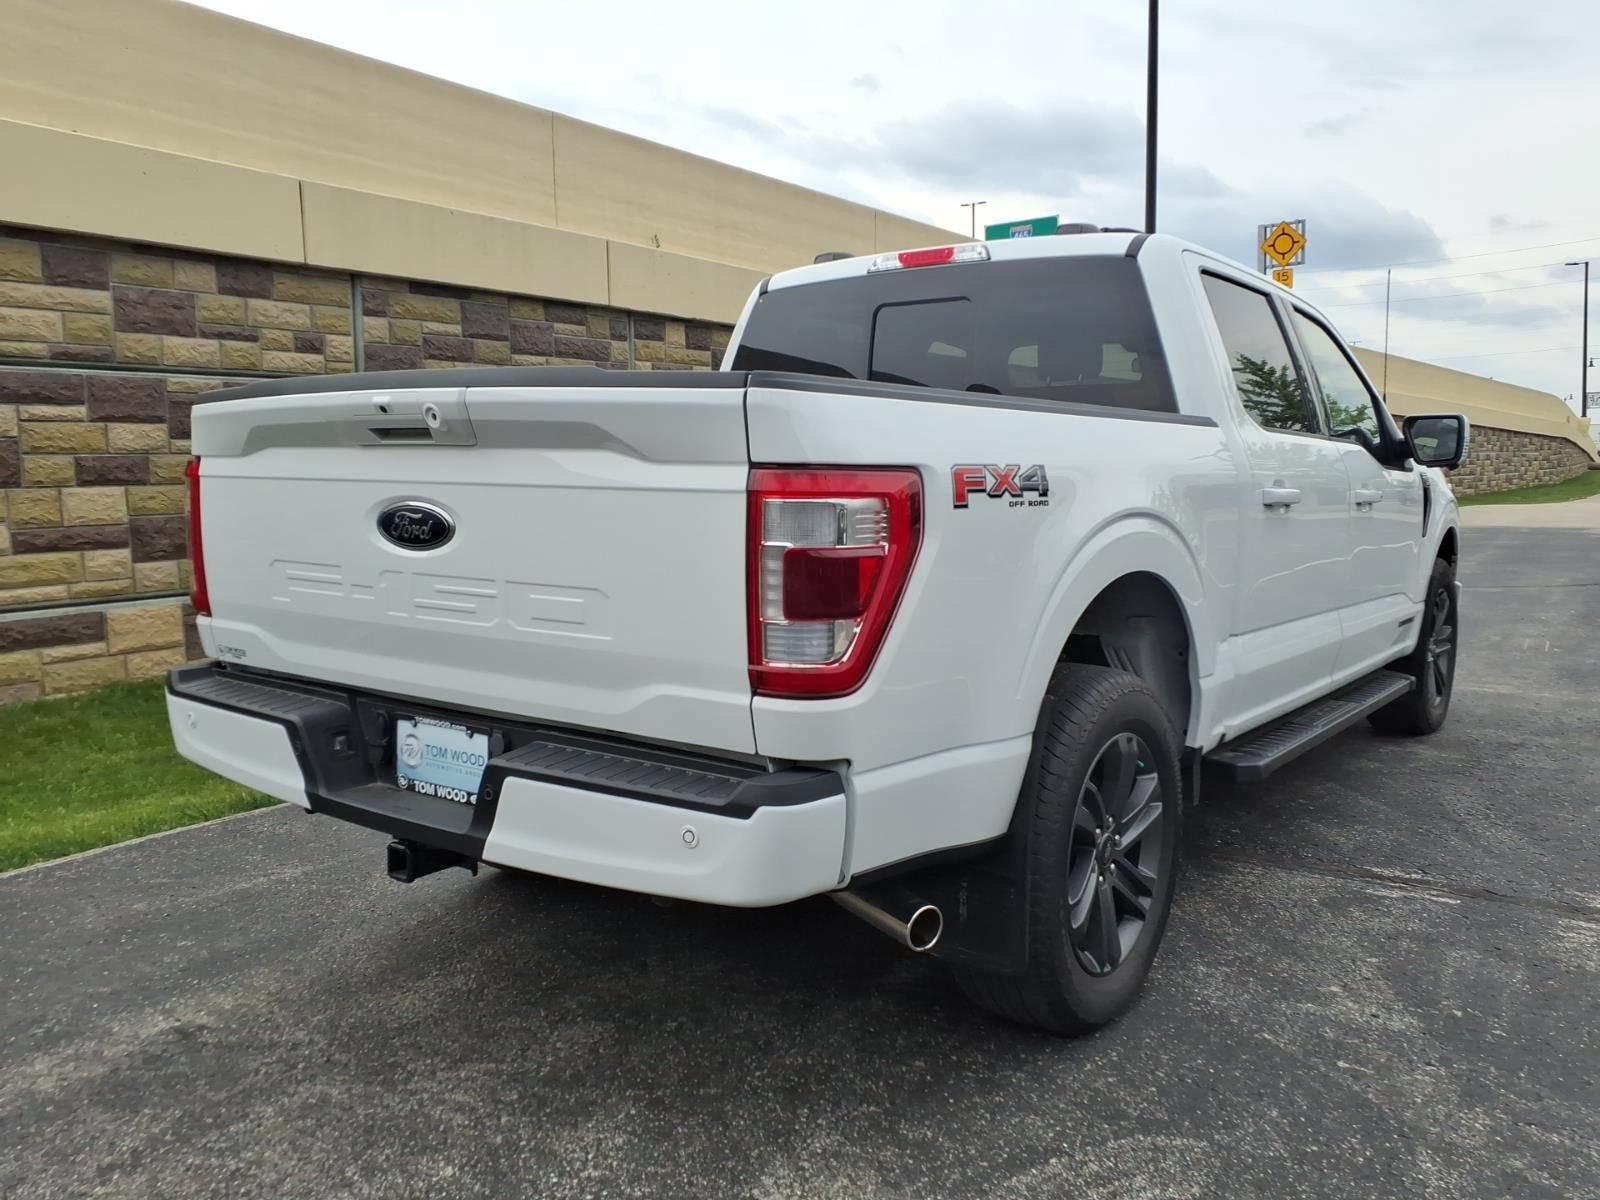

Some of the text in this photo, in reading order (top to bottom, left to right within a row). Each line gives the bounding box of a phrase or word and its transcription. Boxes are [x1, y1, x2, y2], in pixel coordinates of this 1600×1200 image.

[1276, 271, 1289, 281] 15
[950, 464, 1049, 509] FX4
[1008, 499, 1049, 508] OFF ROAD
[390, 511, 433, 539] Ford
[269, 559, 613, 640] F-150
[424, 744, 485, 767] TOM WOOD
[414, 780, 467, 803] TOM WOOD
